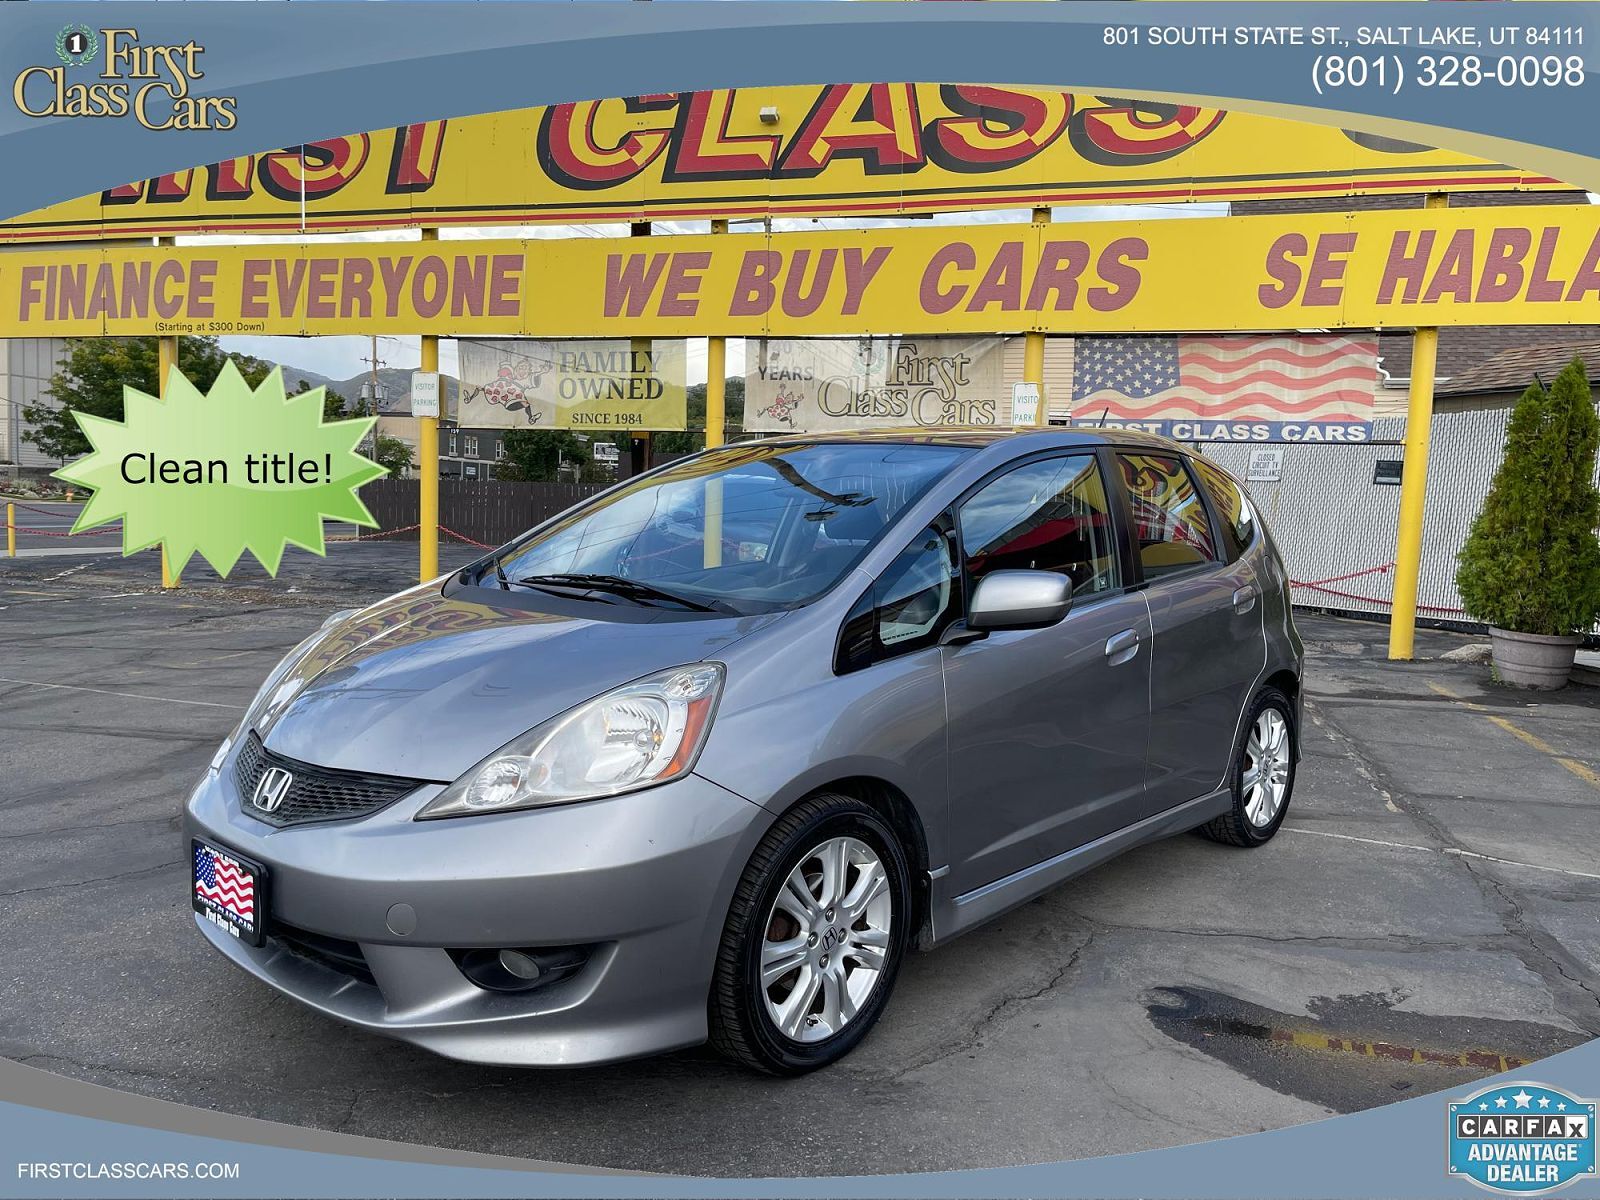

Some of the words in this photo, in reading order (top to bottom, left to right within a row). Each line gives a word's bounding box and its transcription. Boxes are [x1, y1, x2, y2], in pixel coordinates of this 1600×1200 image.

[19, 259, 218, 321] FINANCE
[240, 254, 524, 319] EVERYONE
[603, 252, 712, 318] WE
[728, 247, 893, 317] BUY
[918, 236, 1149, 315] CARS
[1258, 232, 1359, 310] SE
[155, 322, 193, 332] (Starting
[196, 323, 205, 331] at
[209, 322, 233, 331] $300
[236, 322, 265, 332] Down)
[559, 351, 664, 373] FAMILY
[885, 343, 970, 399] First
[758, 366, 813, 381] YEARS
[559, 378, 664, 400] OWNED
[818, 375, 908, 417] Class
[911, 388, 996, 426] Cars
[572, 413, 611, 424] SINCE
[614, 413, 643, 425] 1984
[1172, 423, 1270, 440] CLASS
[1280, 425, 1366, 441] CARS
[1252, 461, 1270, 469] CIRCUIT
[1258, 453, 1276, 461] CLOSED
